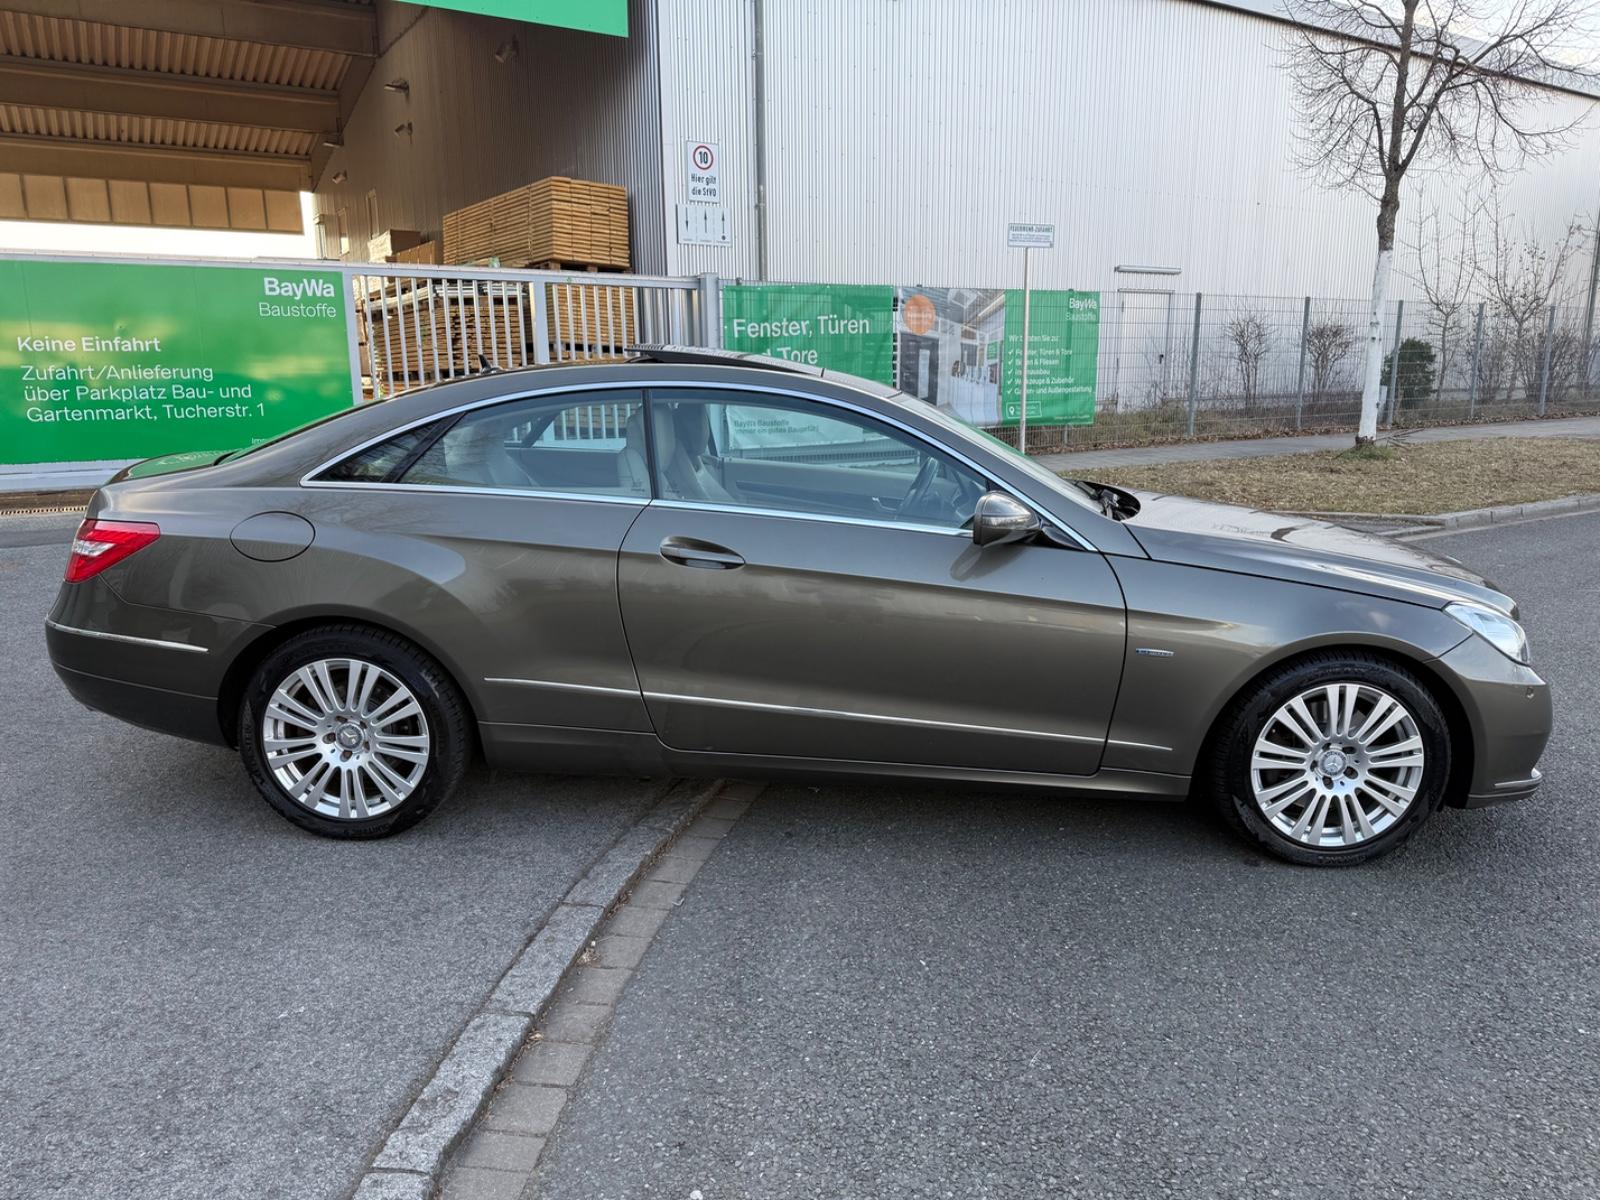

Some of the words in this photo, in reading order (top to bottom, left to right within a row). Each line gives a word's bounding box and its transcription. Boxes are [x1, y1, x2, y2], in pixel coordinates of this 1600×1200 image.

[699, 151, 708, 164] 10
[691, 173, 704, 183] Hier
[705, 175, 716, 186] gilt
[691, 186, 701, 195] die
[702, 187, 717, 197] StVO
[264, 277, 335, 300] BayWa
[259, 302, 336, 318] Baustoffe
[1069, 298, 1097, 310] BayWa
[733, 316, 813, 338] Fenster,
[817, 314, 870, 335] Türen
[17, 335, 76, 352] Keine
[81, 336, 161, 352] Einfahrt
[777, 346, 818, 365] Tore
[20, 364, 214, 382] Zufahrt/Anlieferung
[24, 385, 70, 401] über
[75, 384, 167, 402] Parkplatz
[172, 384, 214, 400] Bau-
[219, 384, 252, 398] und
[26, 406, 157, 422] Gartenmarkt,
[162, 403, 252, 418] Tucherstr.
[257, 402, 265, 417] 1
